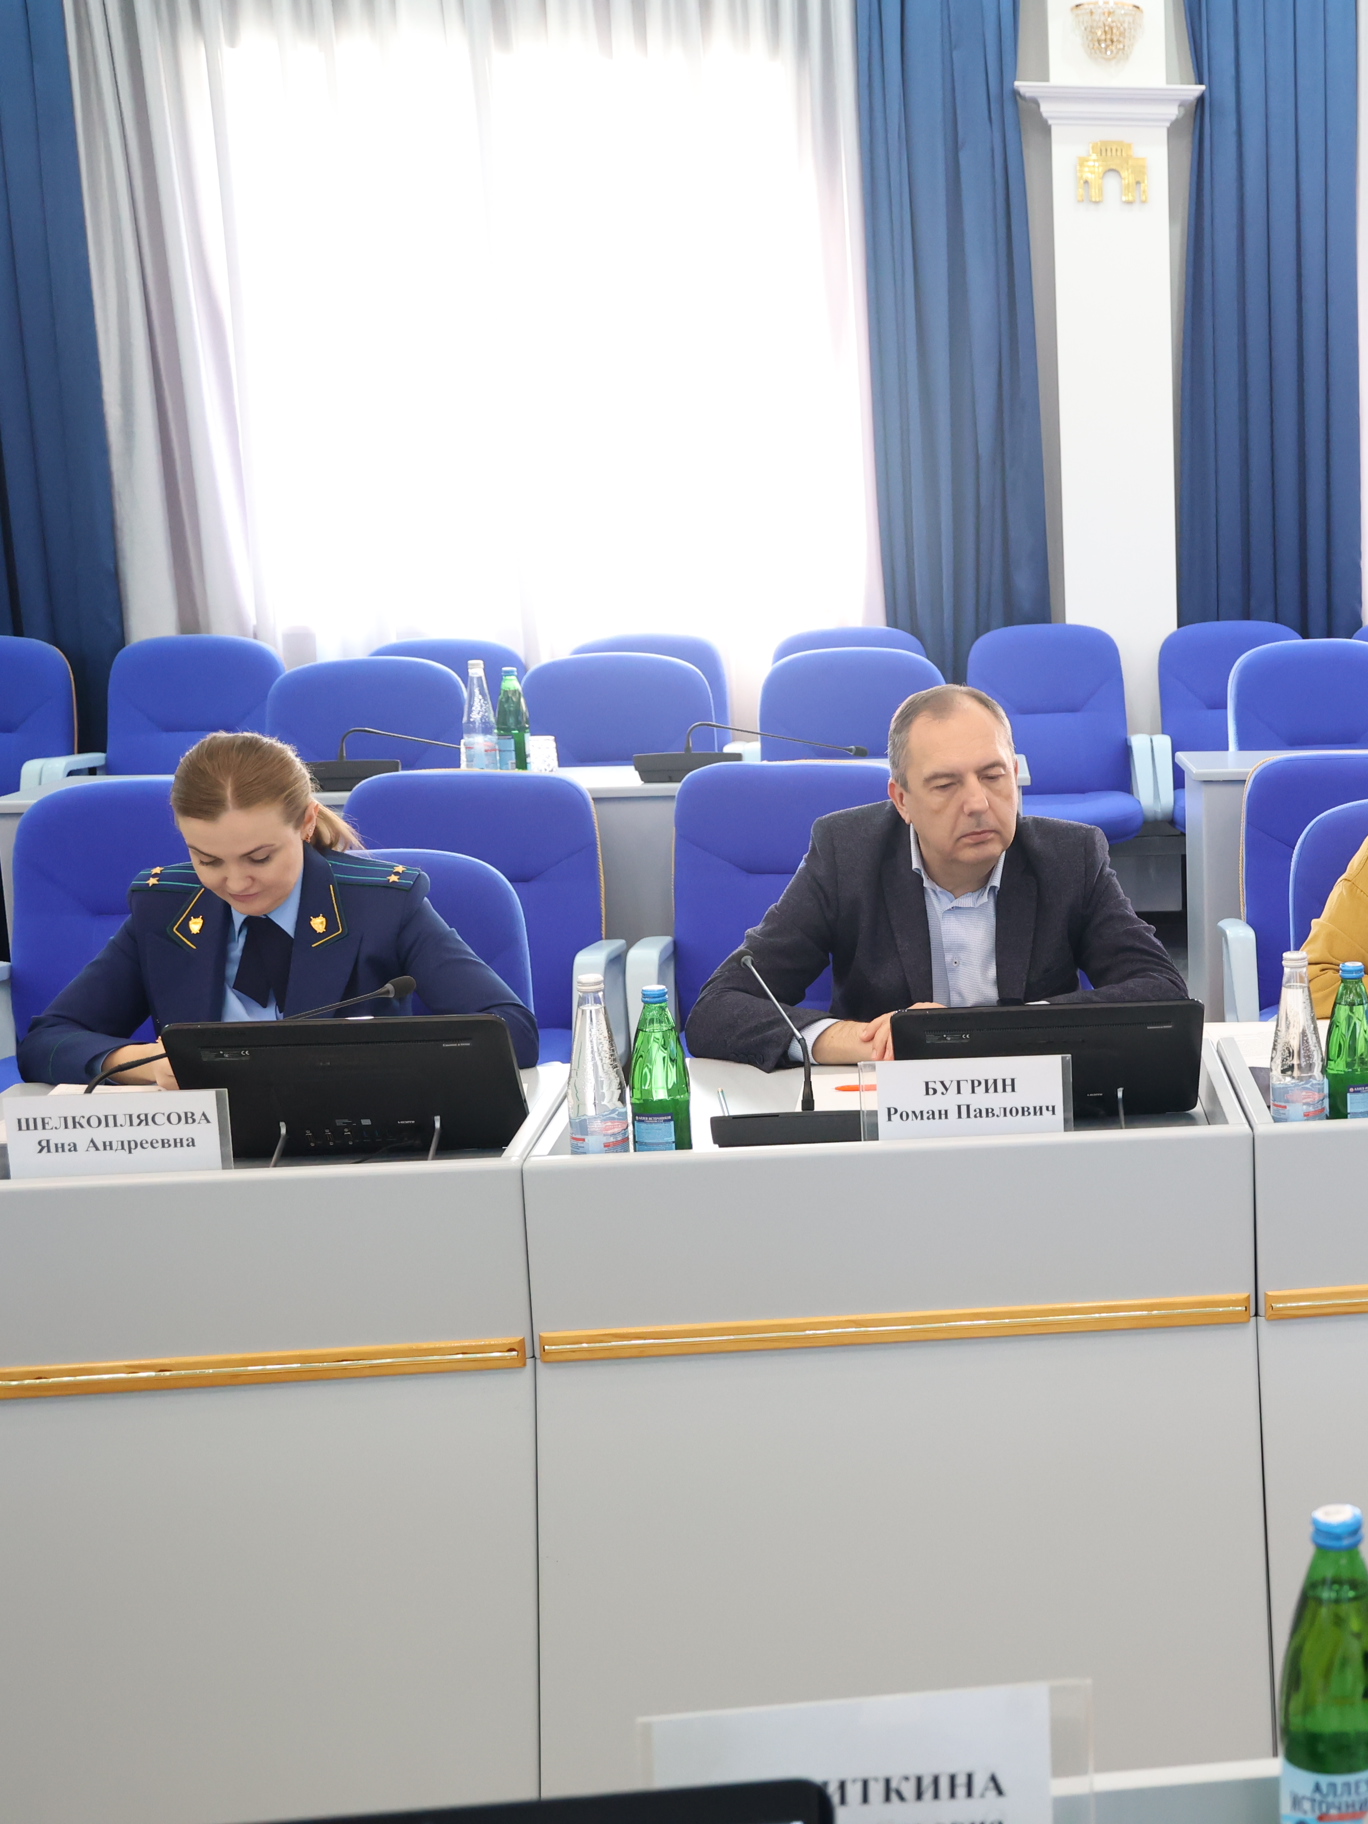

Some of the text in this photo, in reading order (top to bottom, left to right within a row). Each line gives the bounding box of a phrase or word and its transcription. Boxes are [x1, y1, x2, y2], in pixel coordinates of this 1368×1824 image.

[923, 1077, 1017, 1097] БУГРИН
[16, 1110, 212, 1132] ШЕЛКОПЛЯСОВА
[886, 1103, 1057, 1122] Роман Павлович
[37, 1136, 196, 1155] Яна Андреевна
[819, 1770, 1006, 1807] ИТКИНА
